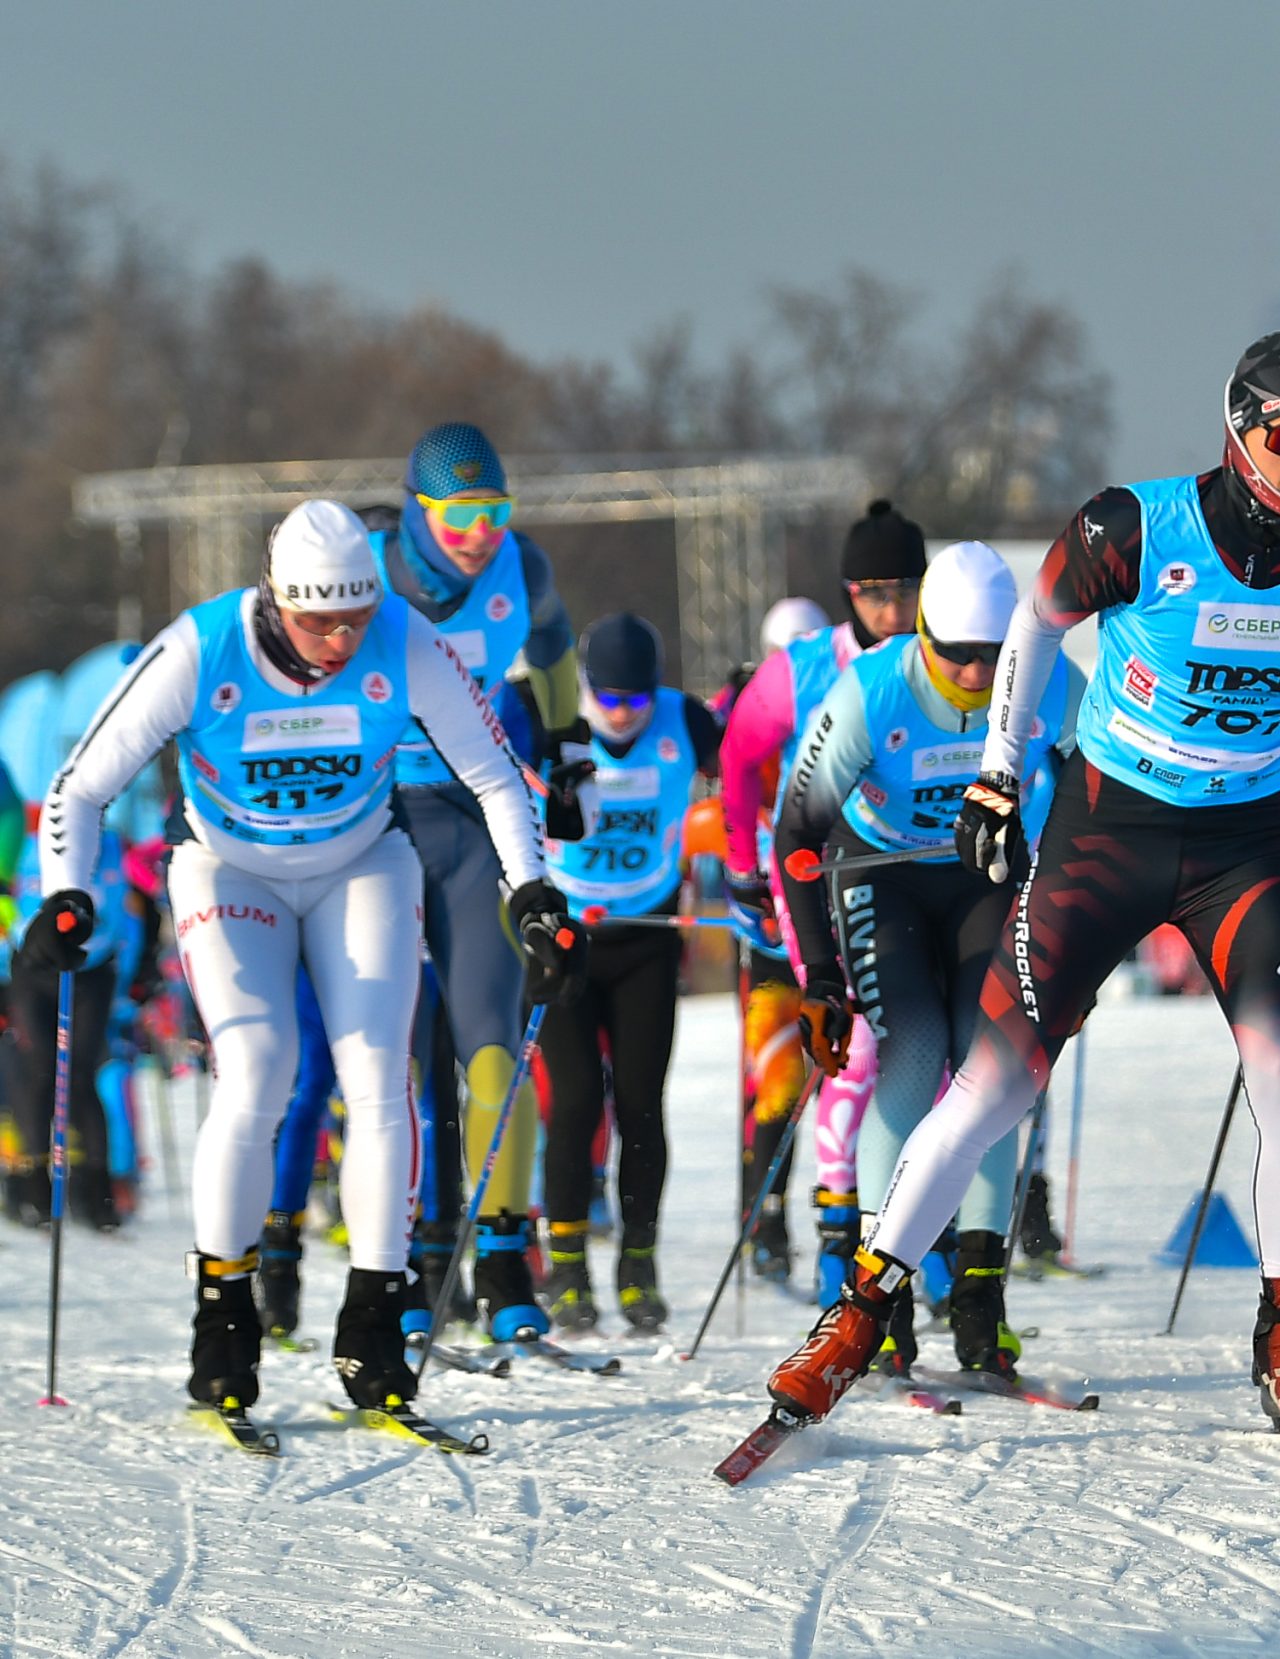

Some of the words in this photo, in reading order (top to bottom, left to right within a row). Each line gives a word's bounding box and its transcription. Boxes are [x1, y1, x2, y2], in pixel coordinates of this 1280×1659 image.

[1212, 694, 1271, 706] FAMILY
[1154, 767, 1187, 782] СПОРТ
[581, 846, 648, 870] 710
